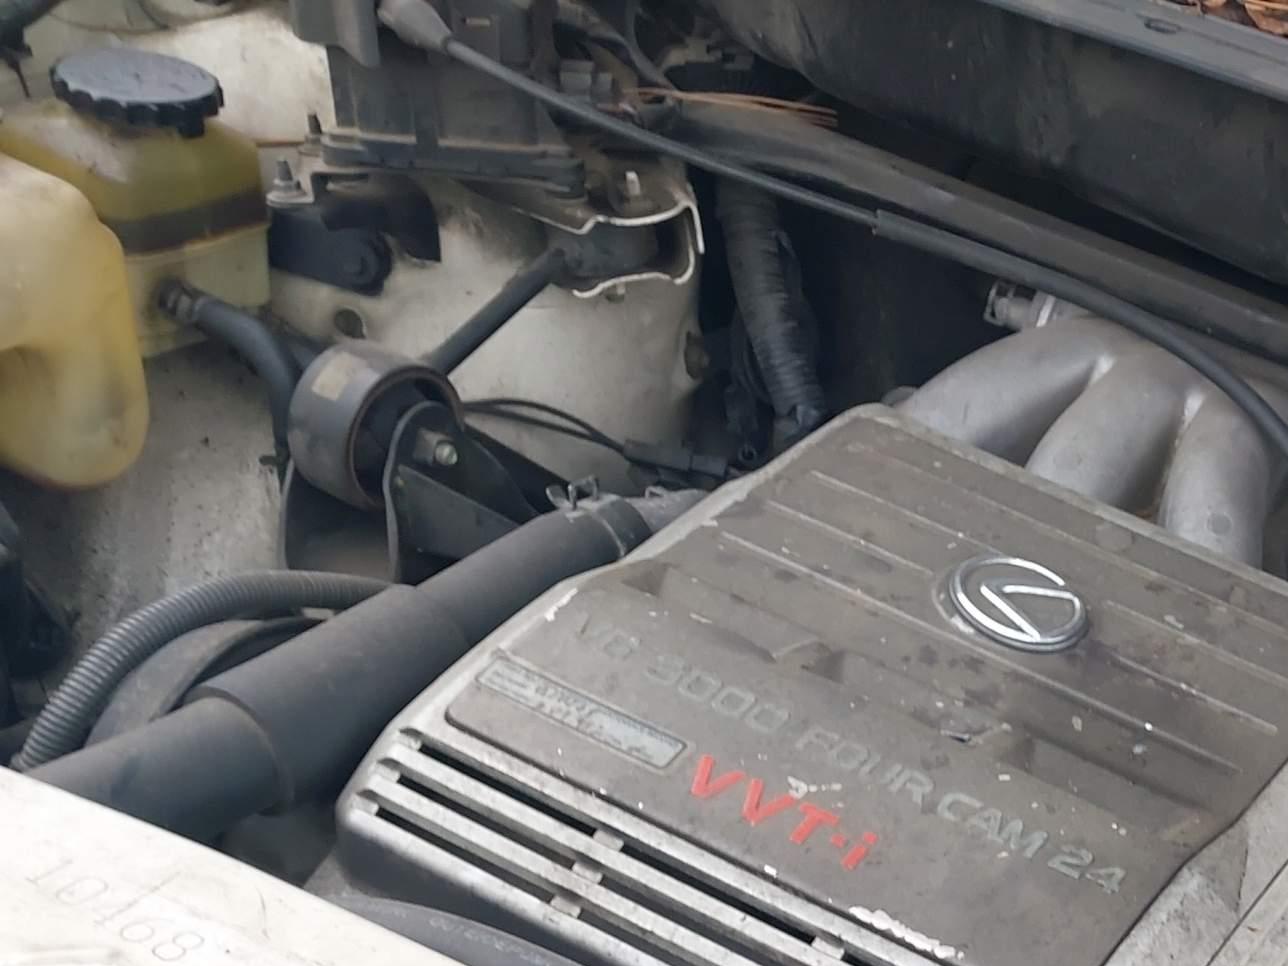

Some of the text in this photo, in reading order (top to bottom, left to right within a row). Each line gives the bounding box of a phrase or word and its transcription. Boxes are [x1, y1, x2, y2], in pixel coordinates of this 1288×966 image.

[646, 652, 790, 732] 3000
[797, 727, 935, 808] FOUR
[937, 792, 1048, 858] CAM
[1049, 845, 1126, 894] 24
[690, 754, 879, 870] VVT-i
